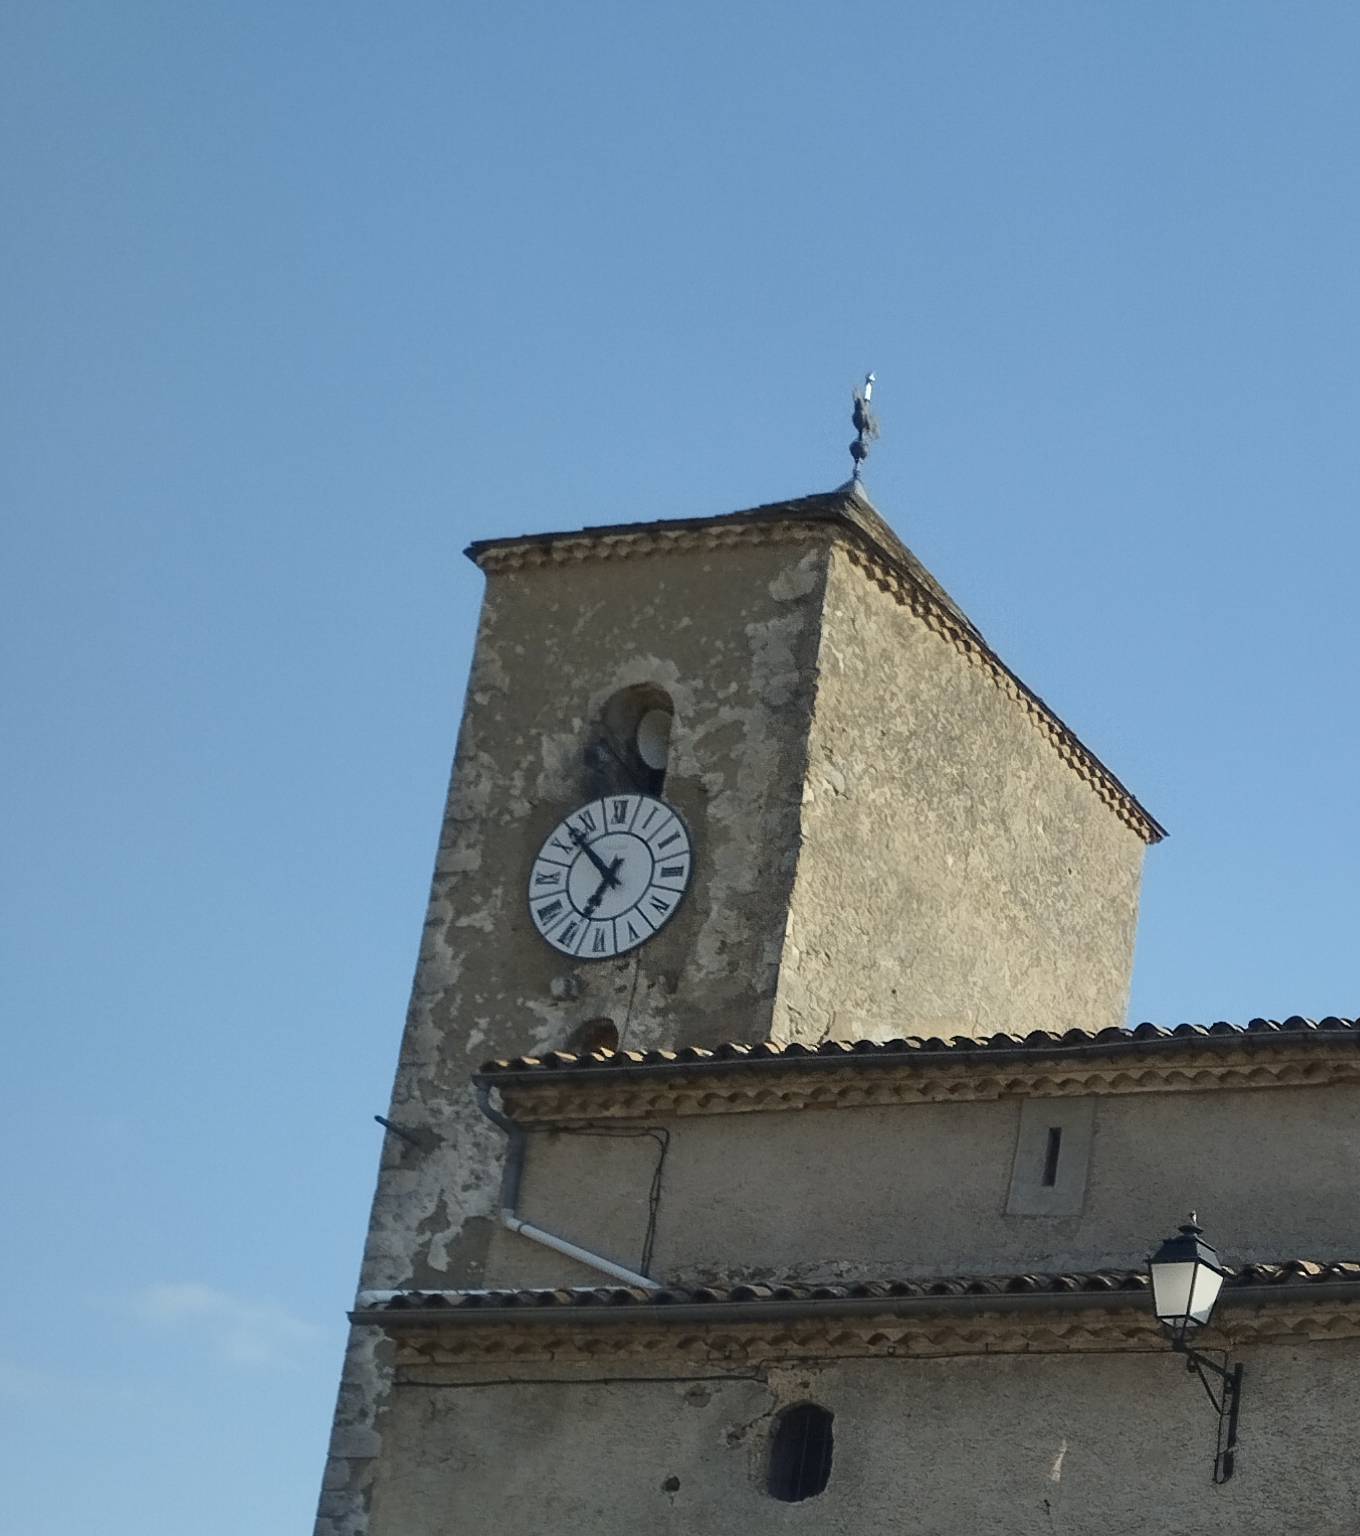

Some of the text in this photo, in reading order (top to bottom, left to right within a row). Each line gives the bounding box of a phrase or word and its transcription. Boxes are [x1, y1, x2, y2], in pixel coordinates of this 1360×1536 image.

[611, 800, 629, 824] XII
[641, 806, 659, 829] I
[551, 837, 574, 855] X
[535, 871, 562, 885] IX
[661, 865, 684, 877] III
[557, 919, 580, 948] VII
[592, 927, 606, 953] VI
[628, 920, 641, 943] V
